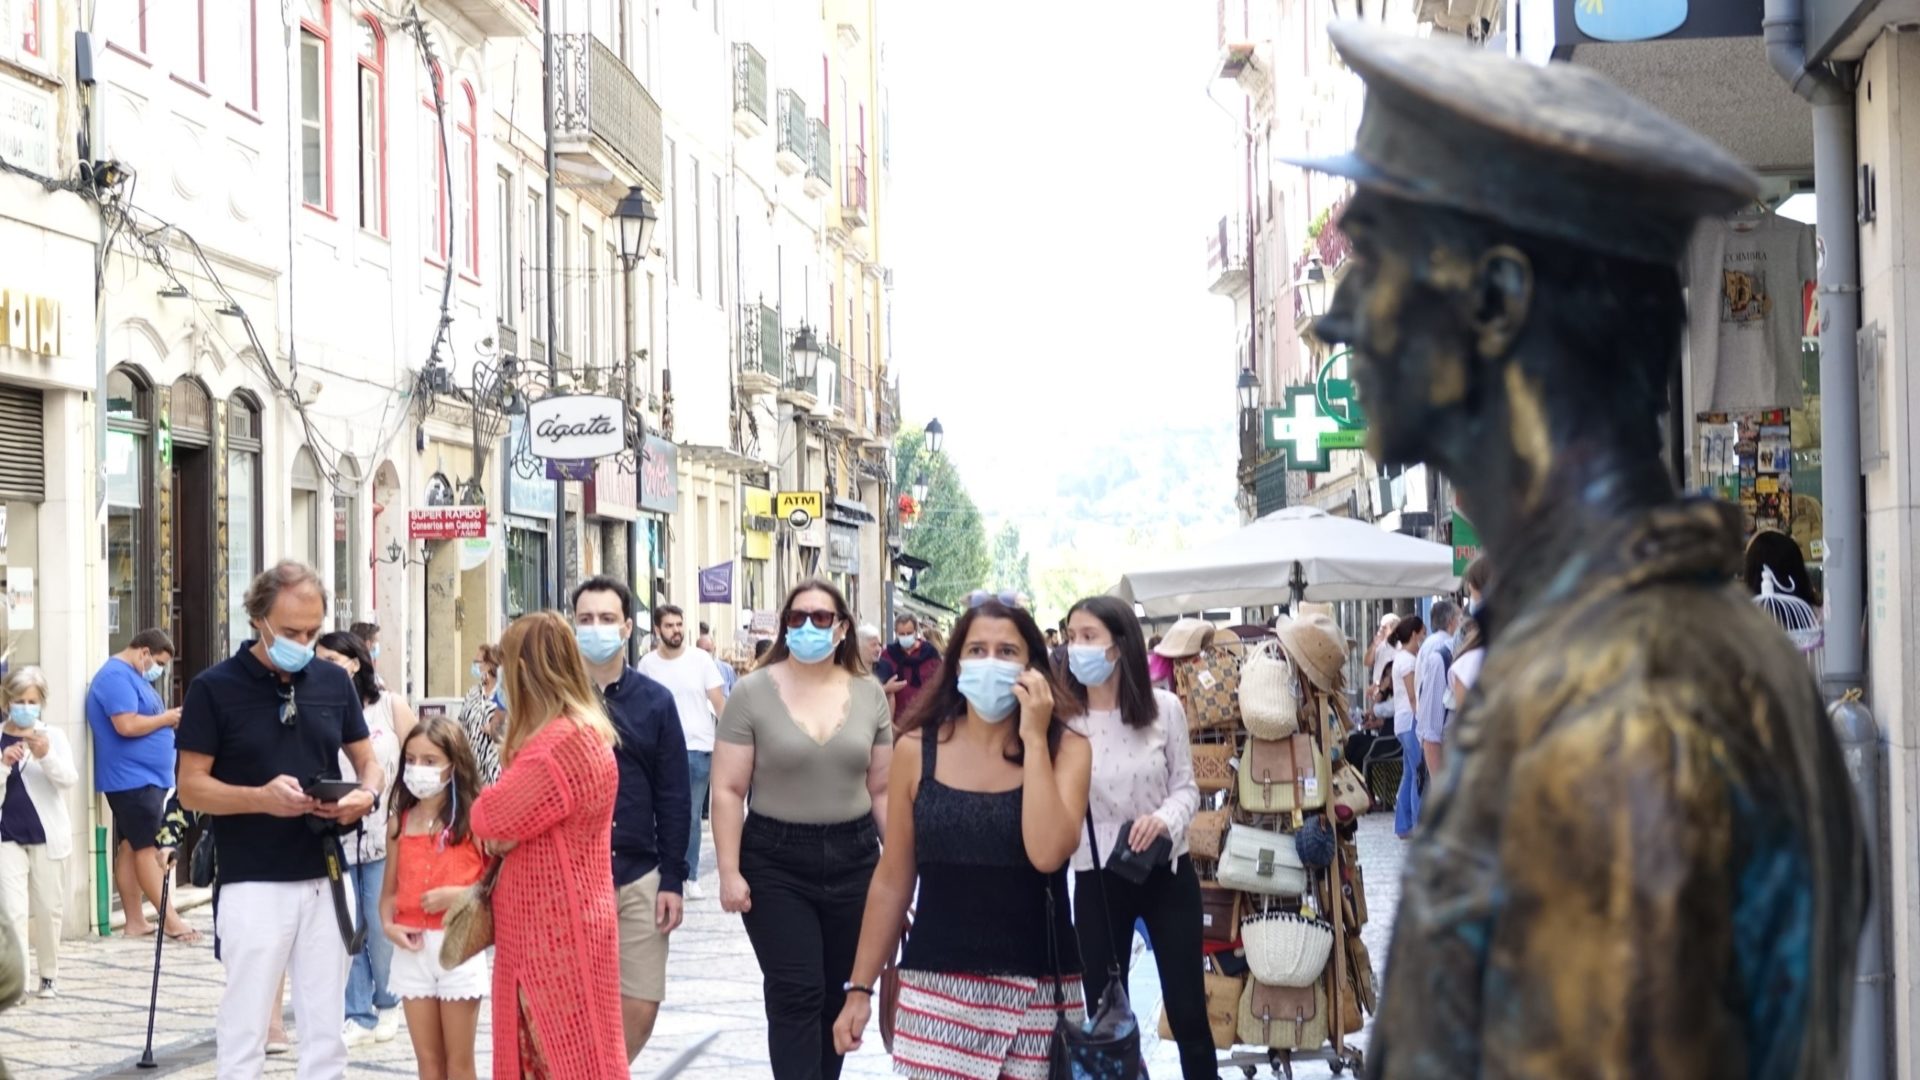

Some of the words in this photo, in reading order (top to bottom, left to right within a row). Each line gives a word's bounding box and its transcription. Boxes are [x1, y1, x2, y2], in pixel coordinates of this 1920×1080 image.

[783, 496, 815, 506] ATM
[411, 510, 442, 520] SUPER
[411, 521, 443, 531] Consertos
[445, 522, 455, 530] em
